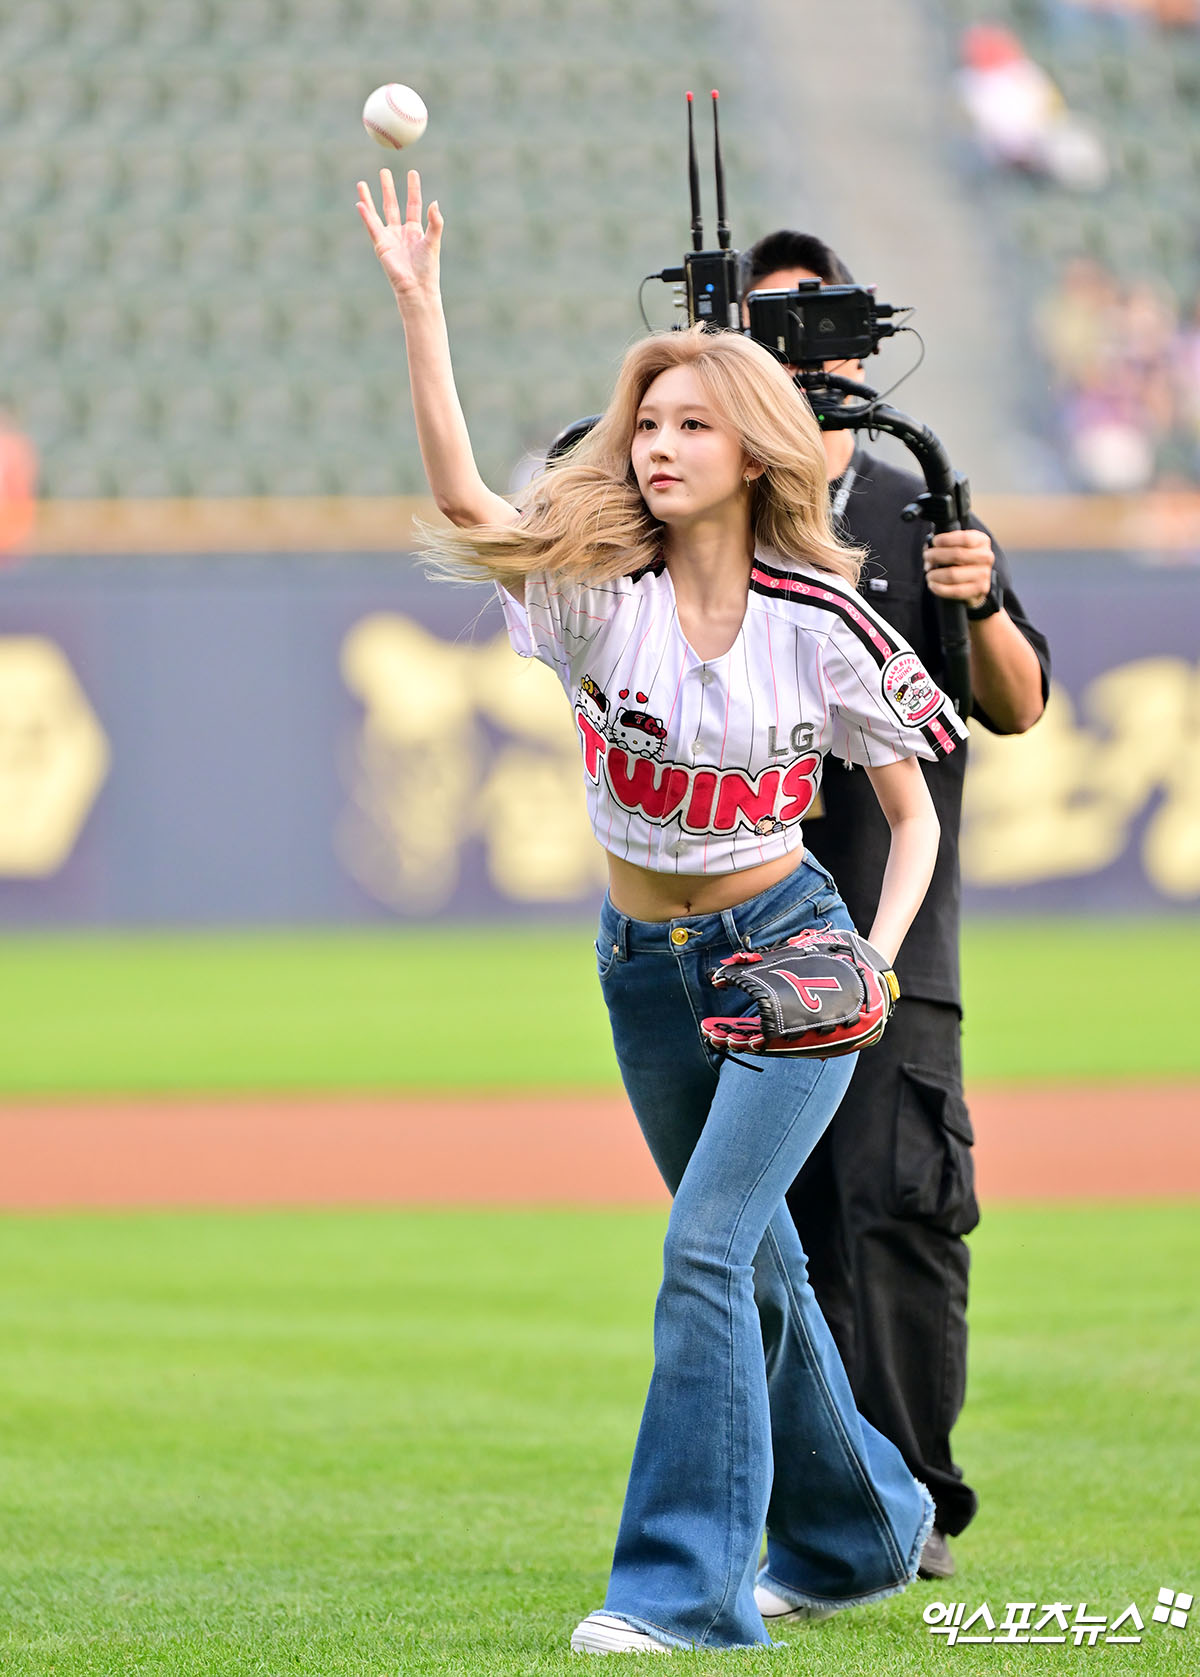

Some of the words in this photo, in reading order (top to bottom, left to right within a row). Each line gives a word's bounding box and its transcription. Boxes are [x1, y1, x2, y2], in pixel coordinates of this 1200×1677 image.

[894, 664, 913, 683] TWINS
[768, 721, 815, 758] LG
[577, 709, 820, 832] TWINS
